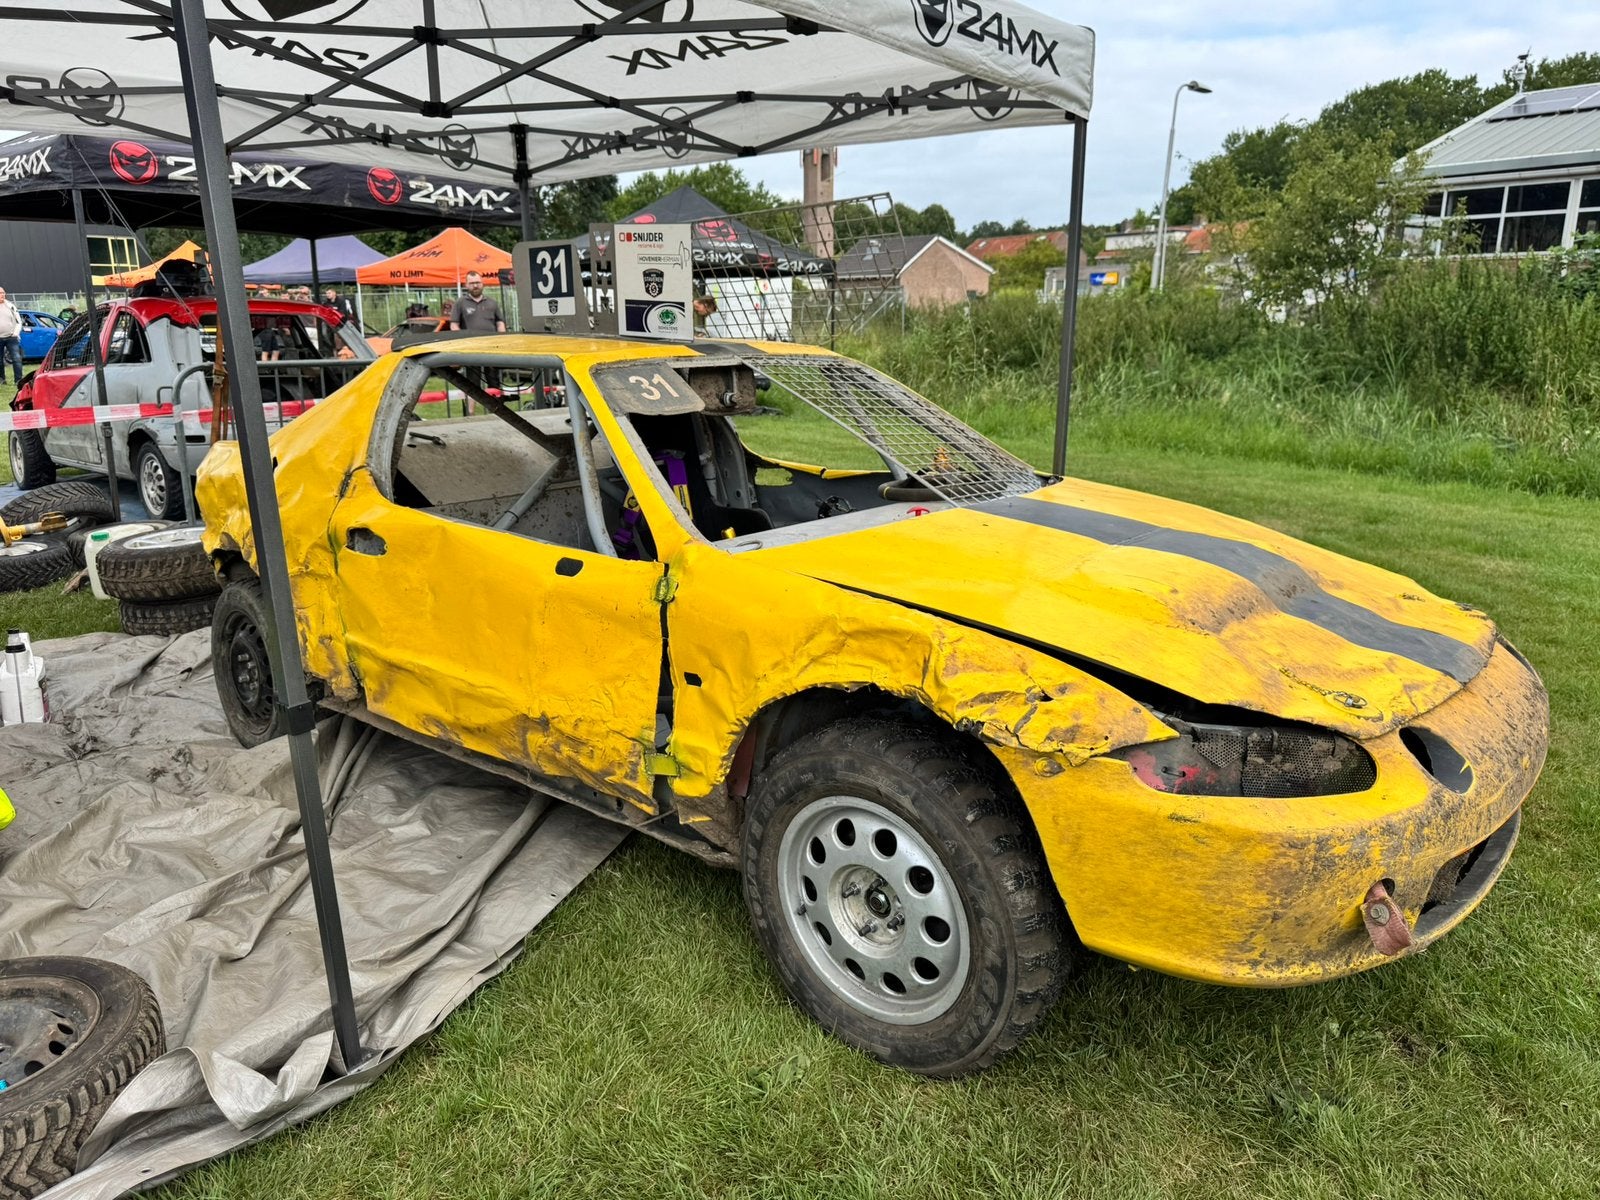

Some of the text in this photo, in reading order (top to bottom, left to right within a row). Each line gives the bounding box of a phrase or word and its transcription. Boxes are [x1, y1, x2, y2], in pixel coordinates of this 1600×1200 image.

[957, 2, 1060, 77] 24MX
[0, 146, 52, 181] 24MX
[166, 155, 312, 190] 2MX
[408, 179, 514, 213] 24MX
[633, 232, 664, 242] SNIJDER
[390, 270, 425, 278] NO LIMIT
[535, 248, 568, 295] 31
[628, 373, 680, 400] 31
